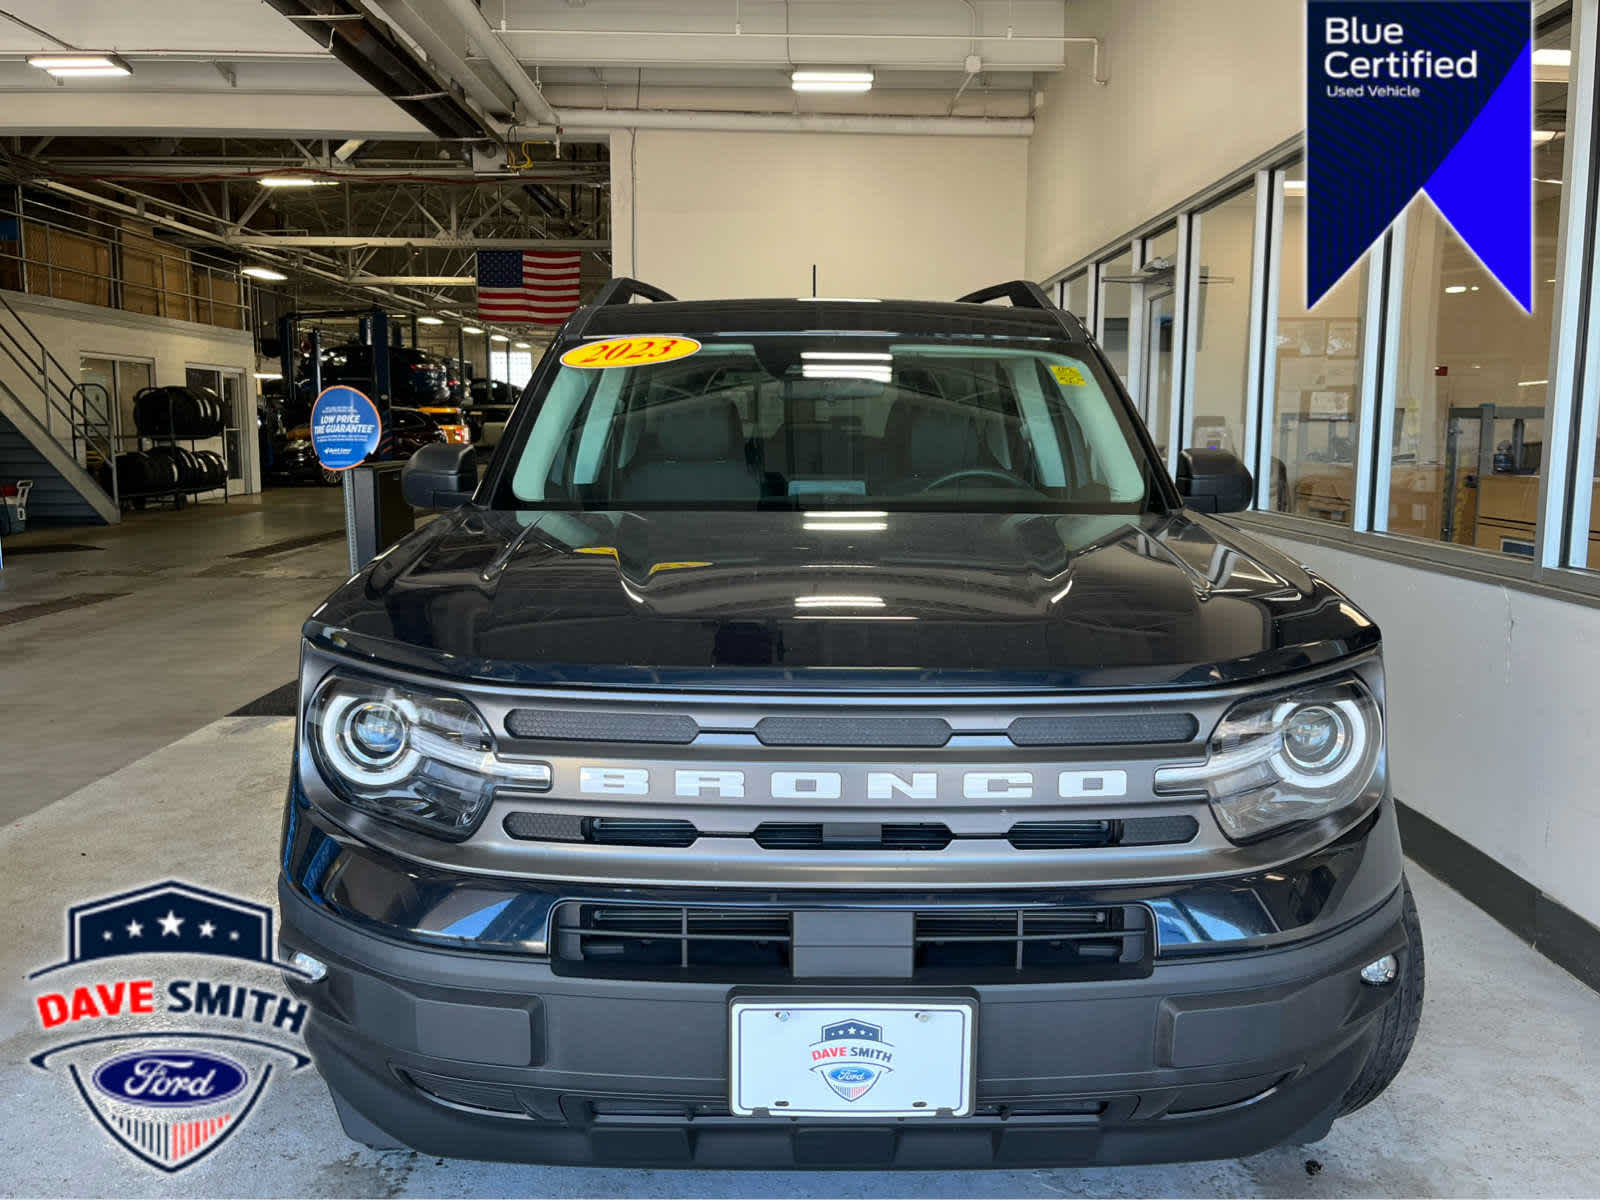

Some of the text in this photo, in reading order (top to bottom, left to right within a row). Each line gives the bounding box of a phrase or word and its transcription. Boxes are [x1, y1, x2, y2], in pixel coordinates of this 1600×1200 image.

[579, 340, 679, 363] 2023
[321, 414, 360, 424] LOW PRICE
[325, 424, 374, 434] GUARANTEE
[579, 766, 1128, 800] BRONCO
[811, 1046, 893, 1063] DAVE SMITH
[837, 1069, 865, 1081] Ford
